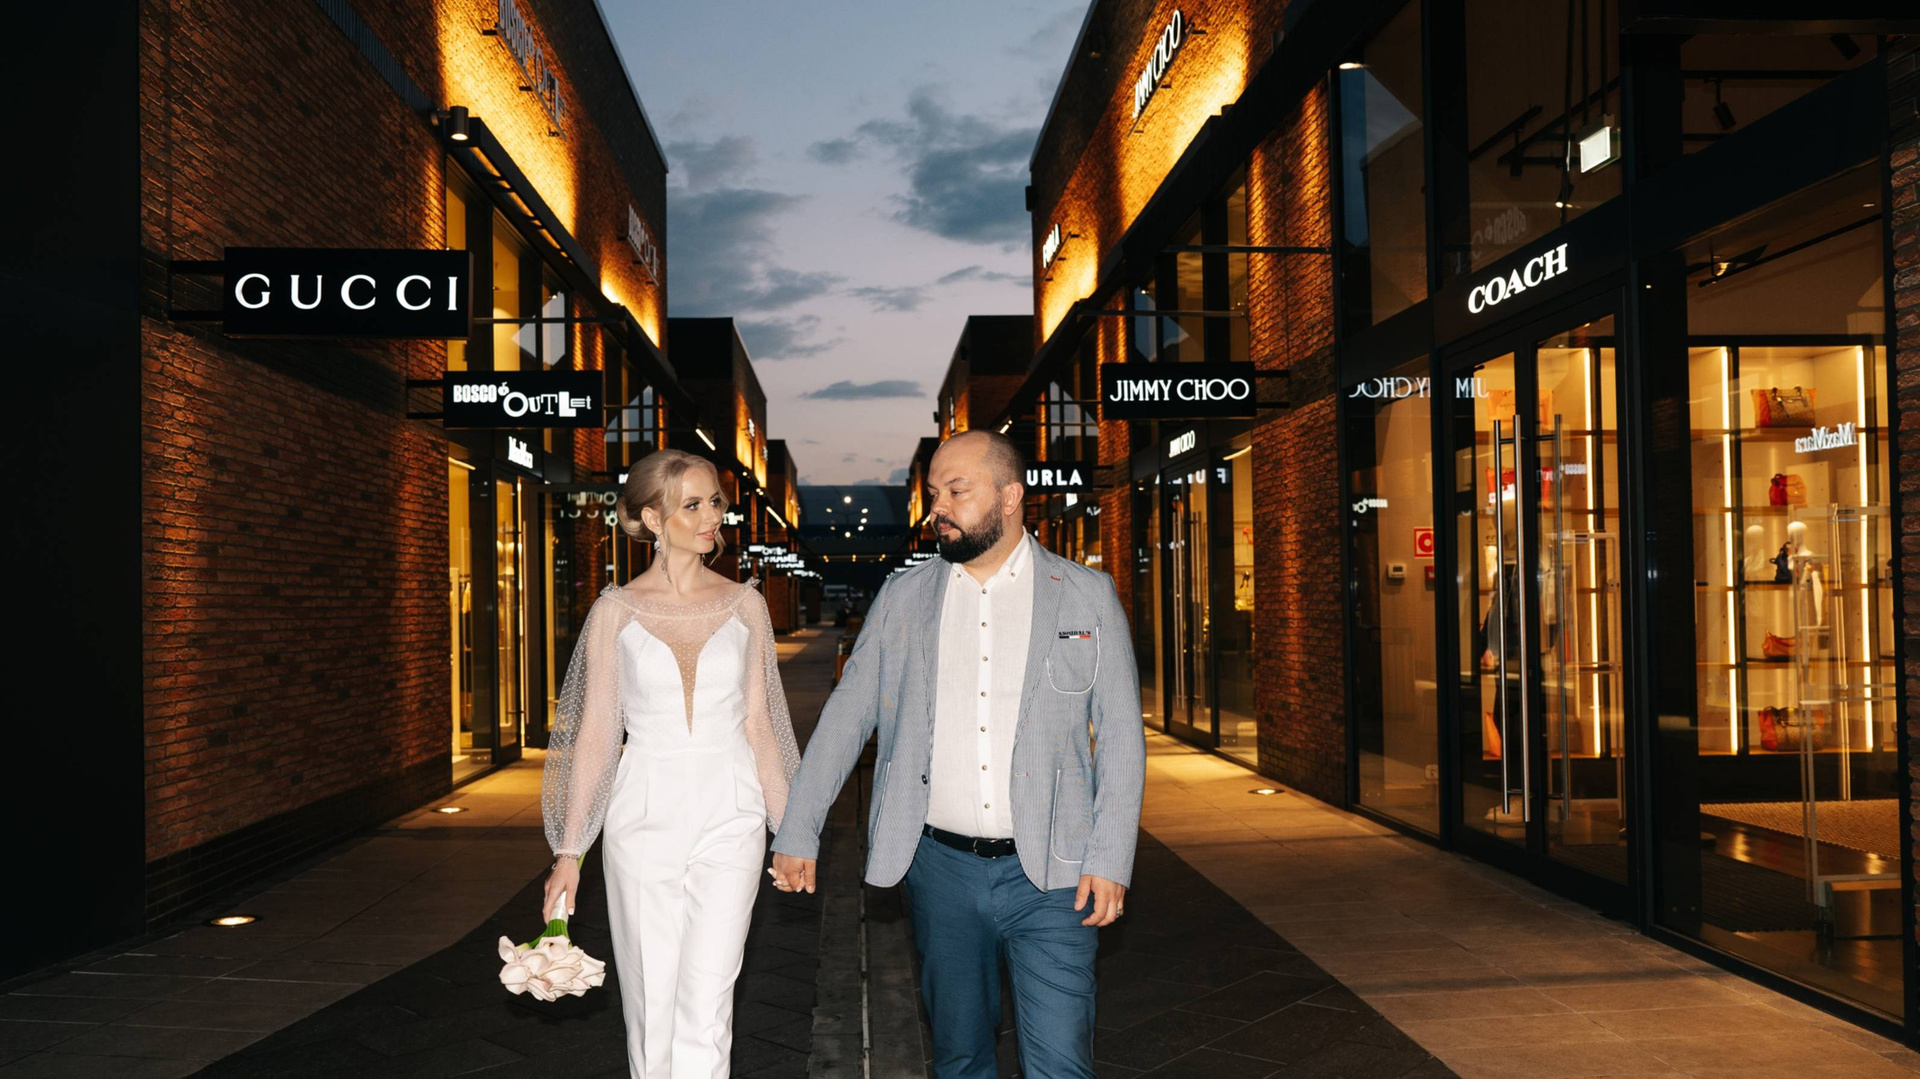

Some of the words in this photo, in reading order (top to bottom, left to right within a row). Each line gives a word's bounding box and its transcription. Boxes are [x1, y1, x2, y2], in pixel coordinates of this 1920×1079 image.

[1468, 243, 1568, 313] COACH
[234, 273, 458, 310] GUCCI
[453, 384, 497, 403] BOSCO
[1110, 380, 1172, 401] JIMMY
[1177, 378, 1249, 401] CHOO
[1026, 469, 1083, 486] URLA
